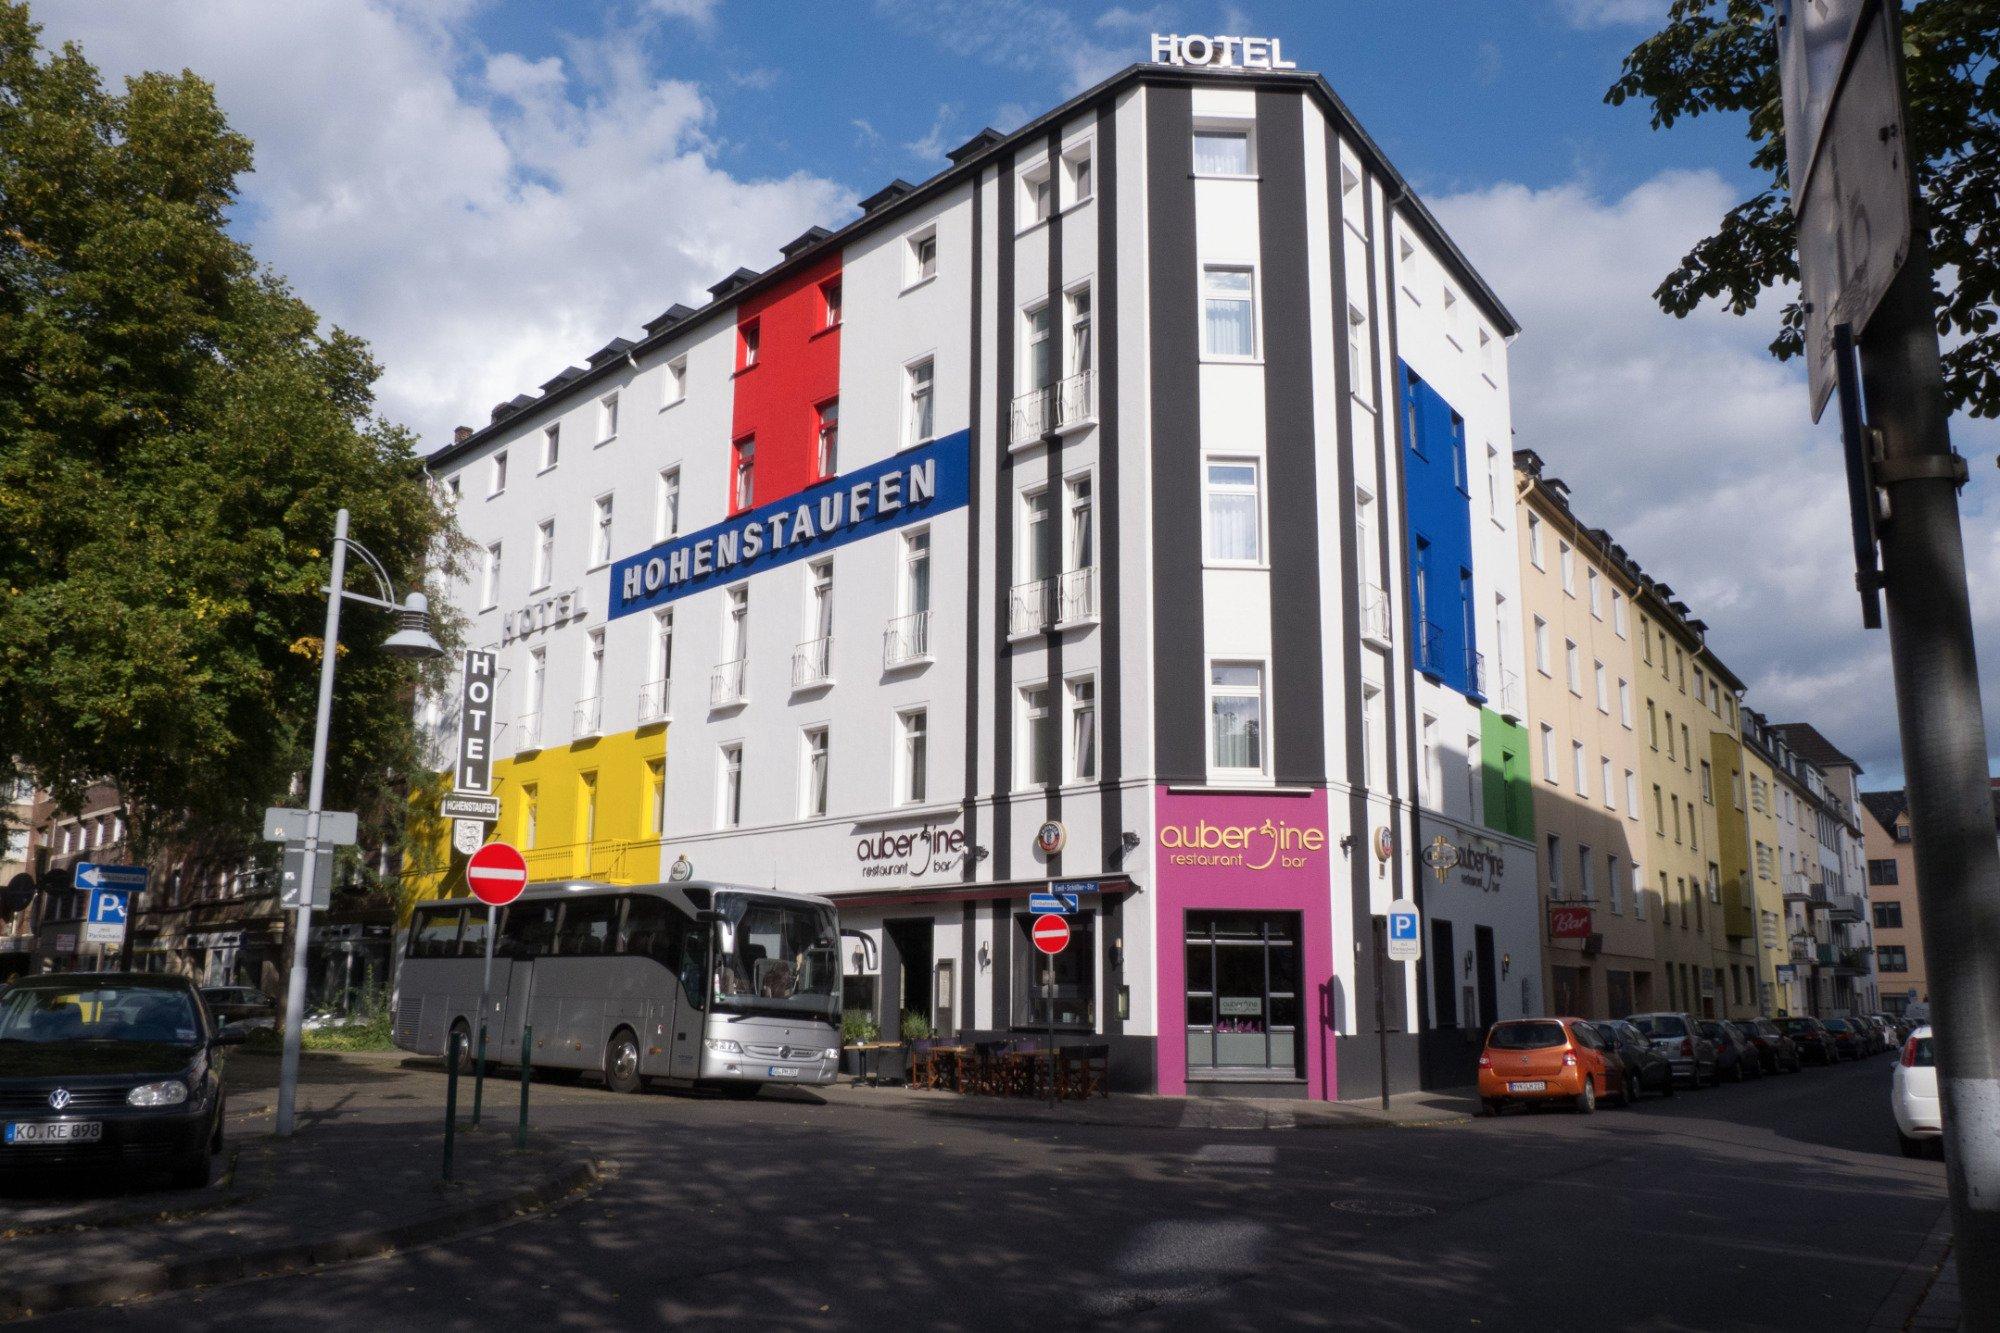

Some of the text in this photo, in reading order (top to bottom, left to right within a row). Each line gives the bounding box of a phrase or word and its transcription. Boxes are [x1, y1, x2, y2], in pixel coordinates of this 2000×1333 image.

[1151, 33, 1296, 69] HOTEL
[623, 458, 936, 600] HOHENSTAUFEN
[502, 587, 588, 644] HOTEL
[466, 653, 489, 788] HOTEL
[446, 800, 496, 813] HOHENSTAUFEN
[863, 859, 951, 877] restaurant bar
[1170, 853, 1307, 868] restaurant bar
[1396, 915, 1411, 937] P
[1554, 912, 1588, 932] Bar
